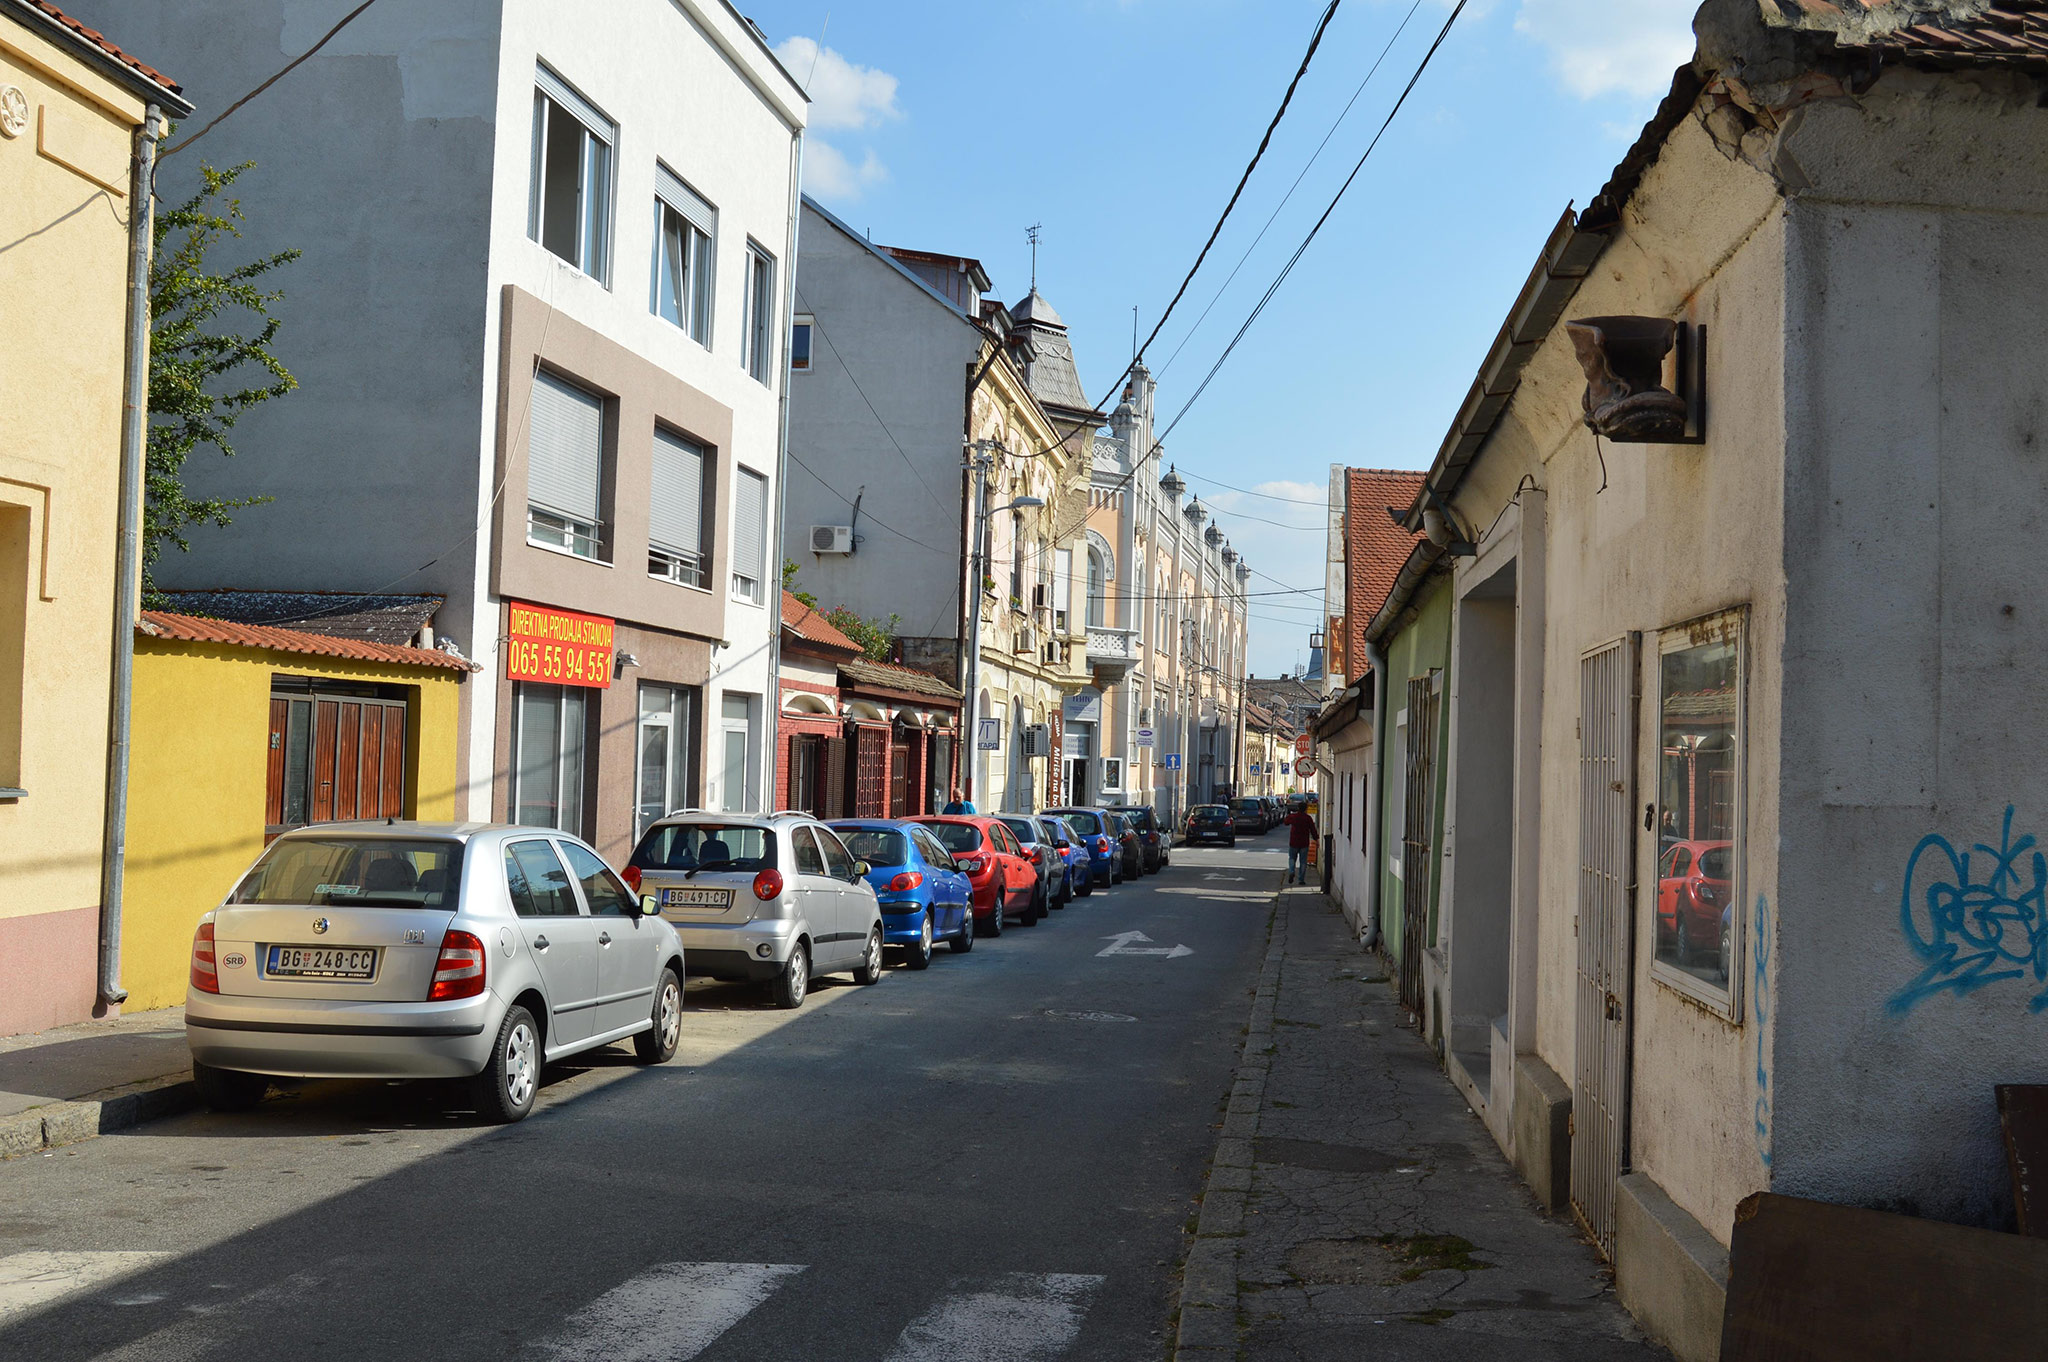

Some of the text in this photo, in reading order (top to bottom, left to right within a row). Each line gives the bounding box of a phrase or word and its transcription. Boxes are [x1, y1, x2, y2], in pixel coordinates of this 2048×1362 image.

[512, 609, 612, 648] DIREKTNA PRODAJA STANOVA
[510, 639, 611, 683] 065 55 94 551
[1297, 741, 1310, 749] STO
[1052, 779, 1059, 792] na
[670, 891, 683, 902] BG
[225, 956, 244, 965] SRB
[281, 950, 301, 968] BG
